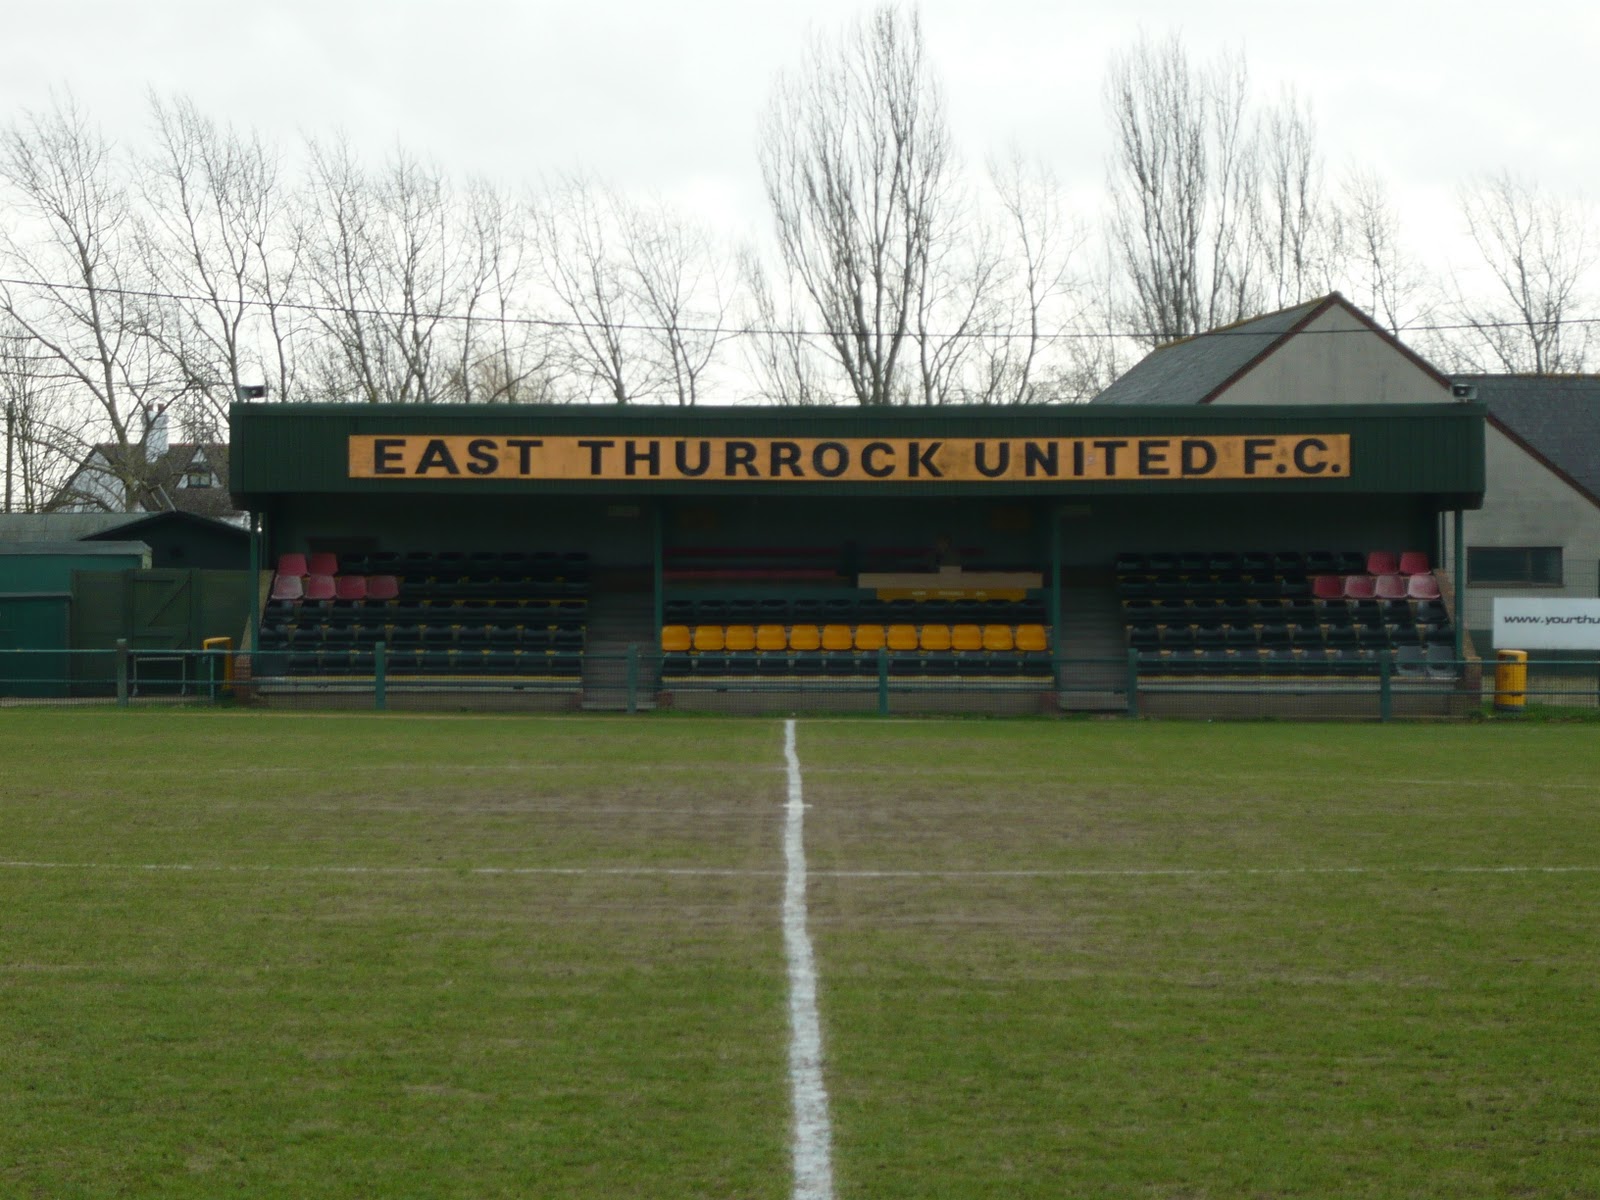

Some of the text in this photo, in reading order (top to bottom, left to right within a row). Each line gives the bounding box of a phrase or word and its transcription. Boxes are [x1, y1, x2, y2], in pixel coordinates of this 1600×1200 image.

[373, 438, 1342, 478] EAST THURROCK UNITED F.C.
[1503, 614, 1600, 625] www.yourthu
